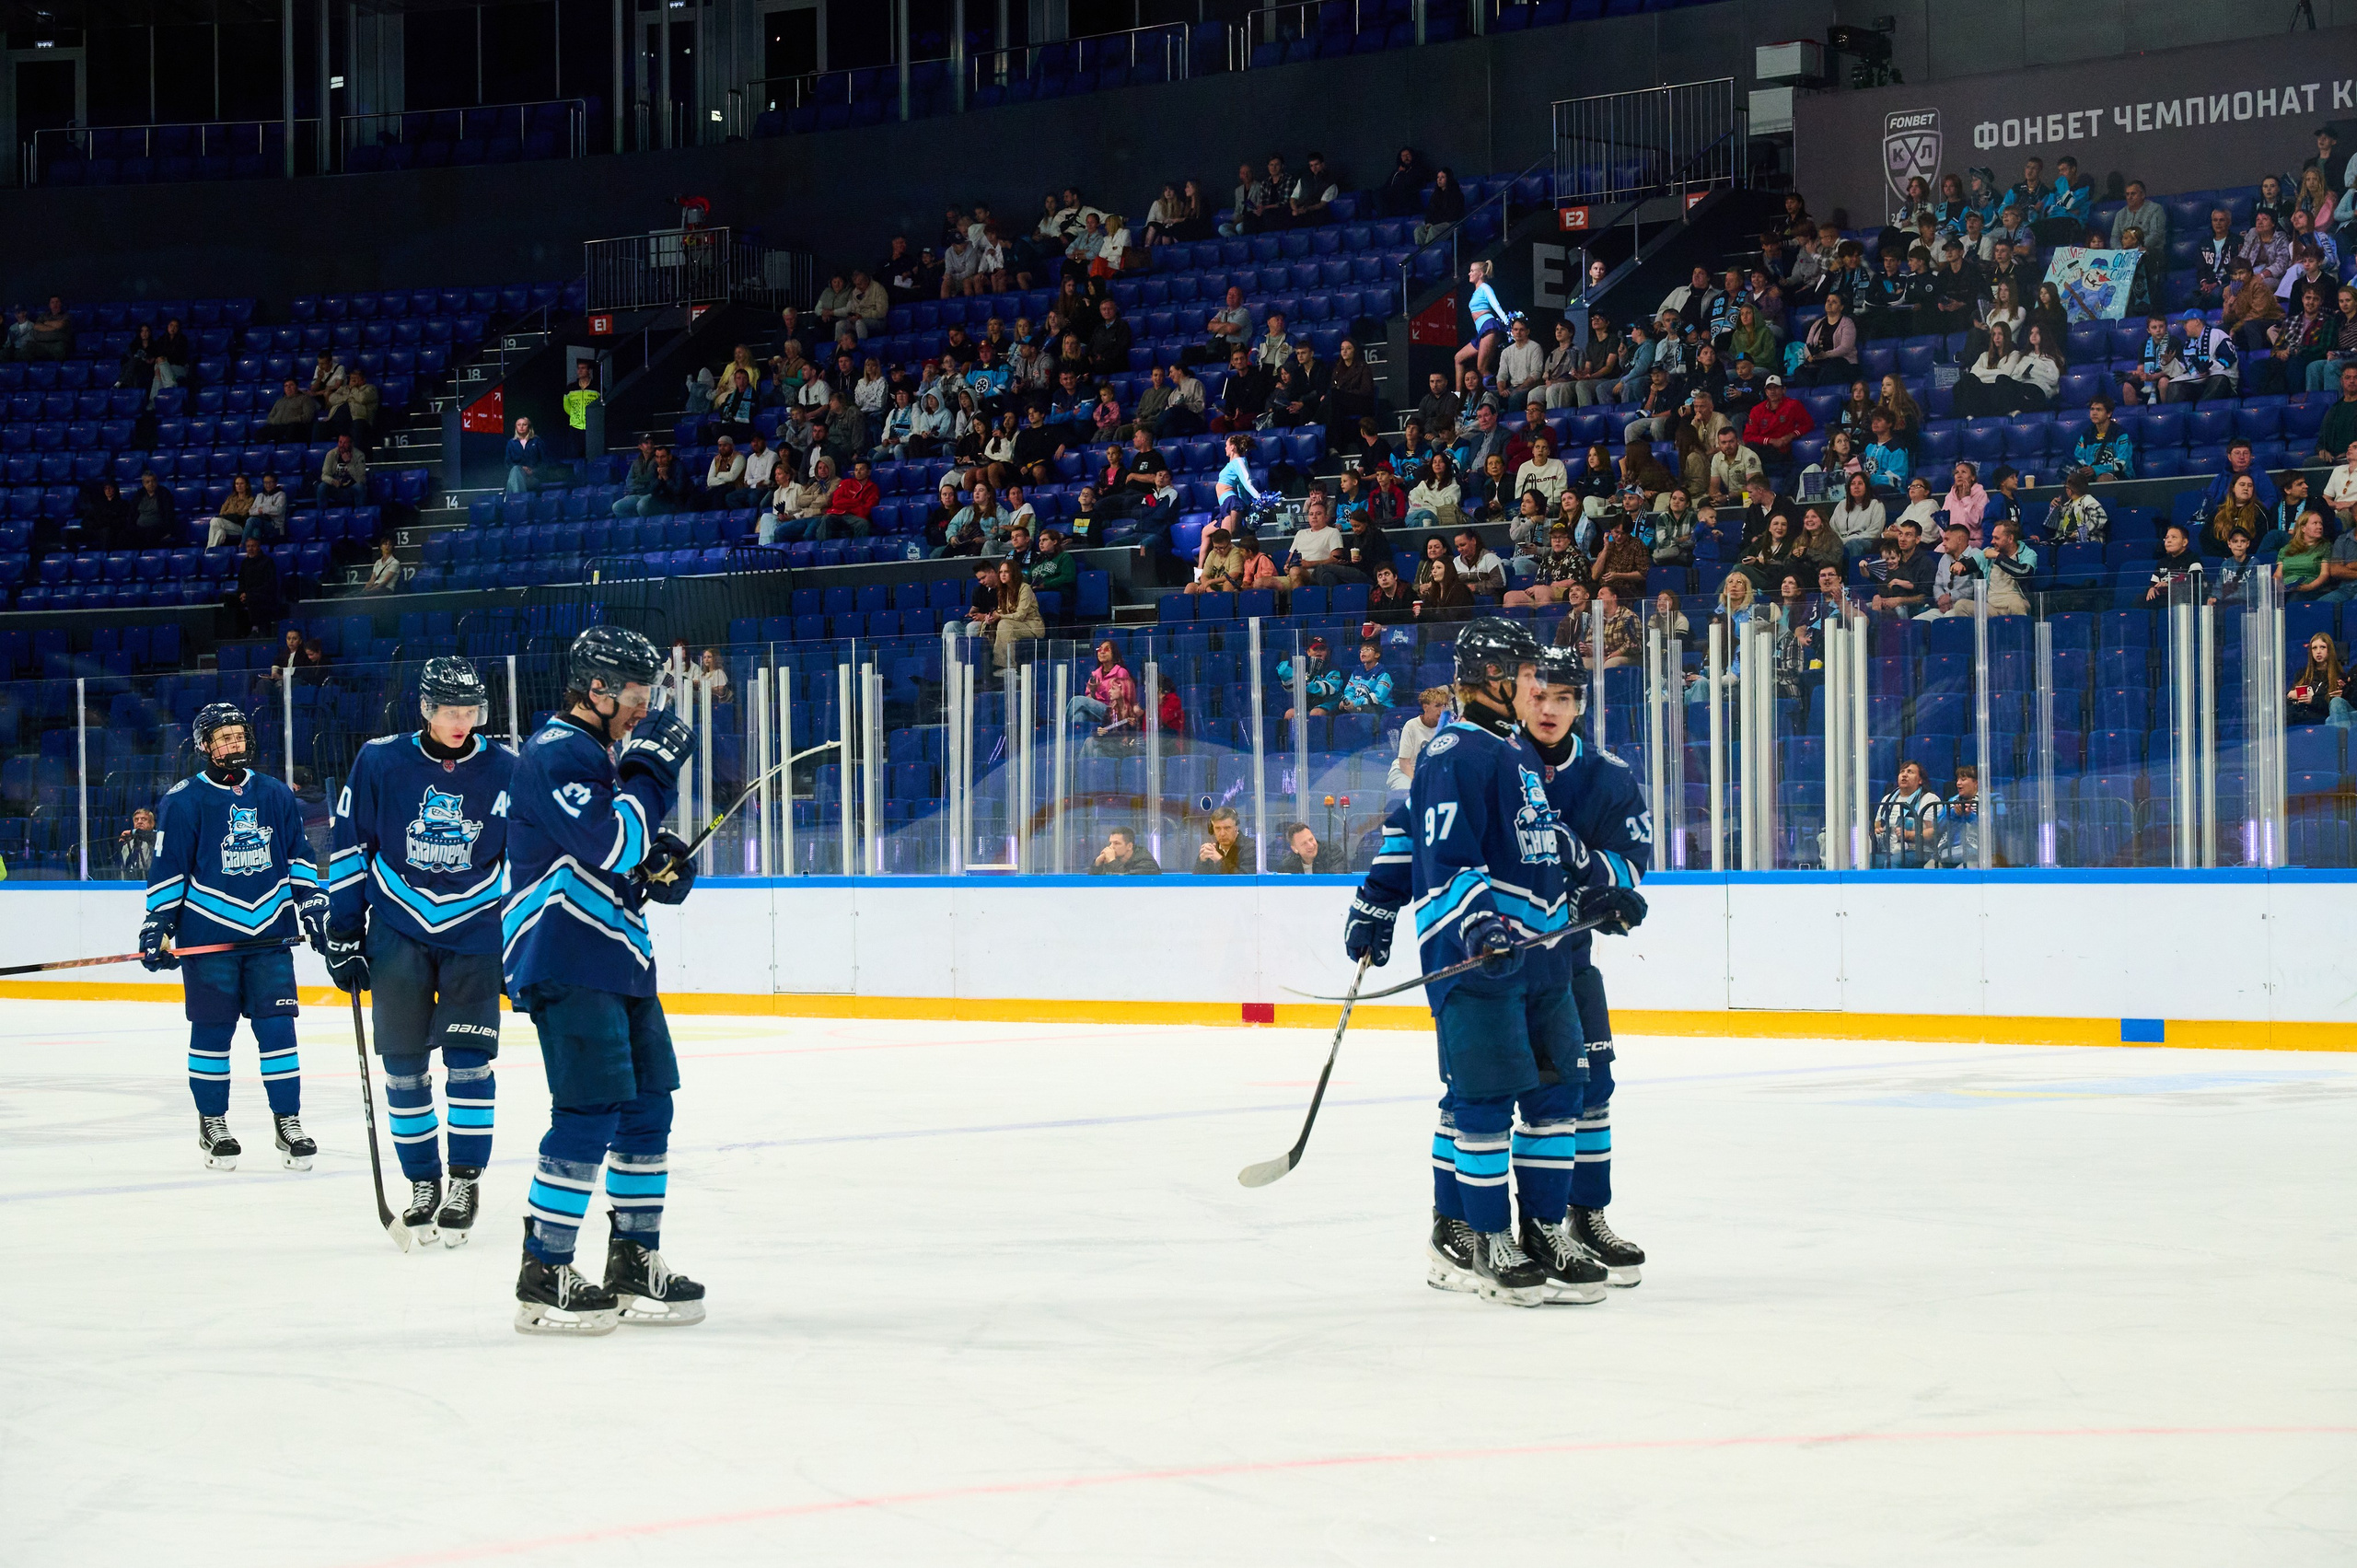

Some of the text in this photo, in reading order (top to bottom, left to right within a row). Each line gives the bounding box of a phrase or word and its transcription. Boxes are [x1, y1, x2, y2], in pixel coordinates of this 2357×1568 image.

[1889, 113, 1935, 130] FONBET
[1974, 79, 2357, 150] ФОНБЕТ ЧЕМПИОНАТ К
[1565, 211, 1585, 226] E2
[594, 319, 607, 331] E1
[504, 338, 517, 349] 19
[467, 368, 481, 379] 18
[429, 401, 444, 412] 17
[394, 435, 409, 446] 16
[446, 495, 459, 508] 14
[396, 531, 410, 545] 13
[346, 570, 358, 584] 12
[458, 673, 473, 686] 40
[1495, 720, 1512, 730] CC
[490, 790, 507, 818] A
[709, 813, 725, 830] CCM
[1424, 801, 1457, 847] 97
[1626, 810, 1654, 844] 35
